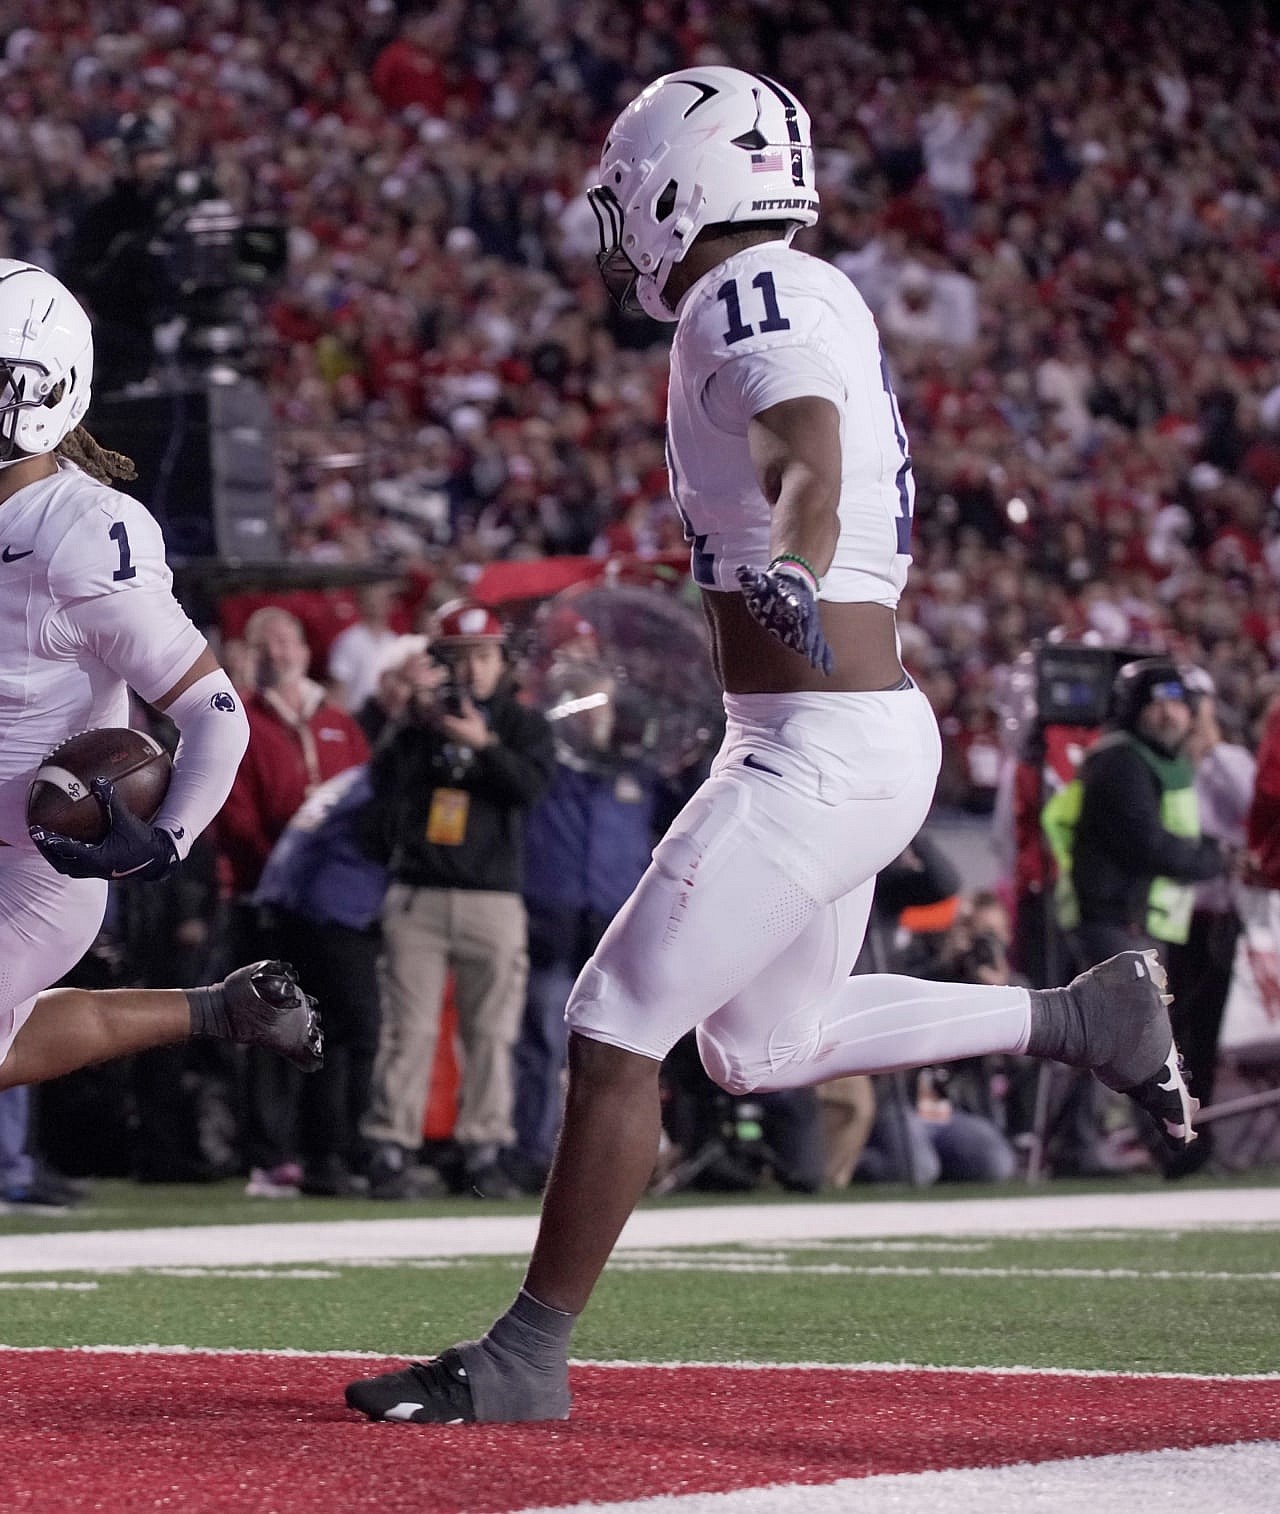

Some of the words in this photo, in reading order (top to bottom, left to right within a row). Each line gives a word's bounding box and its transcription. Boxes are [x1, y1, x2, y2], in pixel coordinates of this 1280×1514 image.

[751, 199, 807, 211] NITTANY
[717, 271, 791, 346] 11
[109, 521, 136, 581] 1
